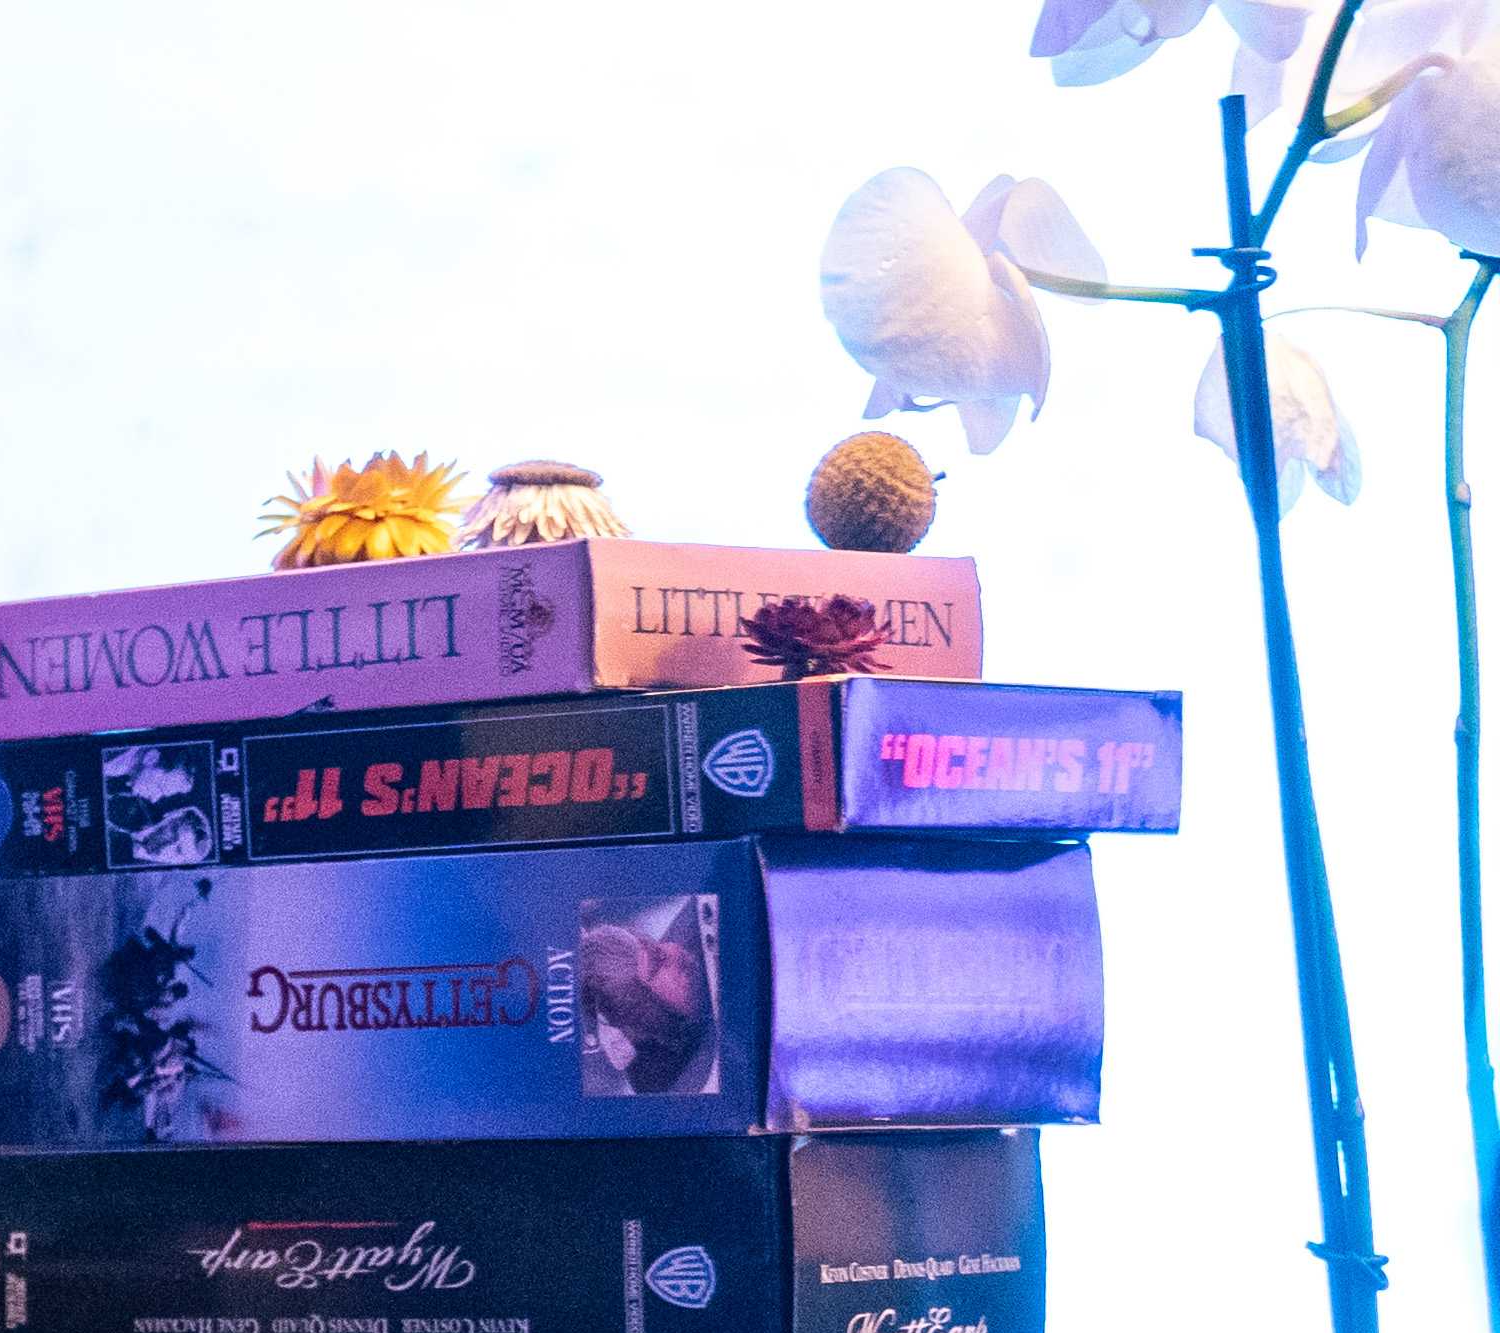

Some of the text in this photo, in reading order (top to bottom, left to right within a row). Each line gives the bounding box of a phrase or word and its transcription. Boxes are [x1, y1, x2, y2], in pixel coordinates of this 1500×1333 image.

[241, 593, 462, 677] LITTLE
[250, 957, 540, 1034] GETTYSBURG
[547, 947, 575, 1044] ACTION
[186, 1220, 475, 1292] Wyatt Earp
